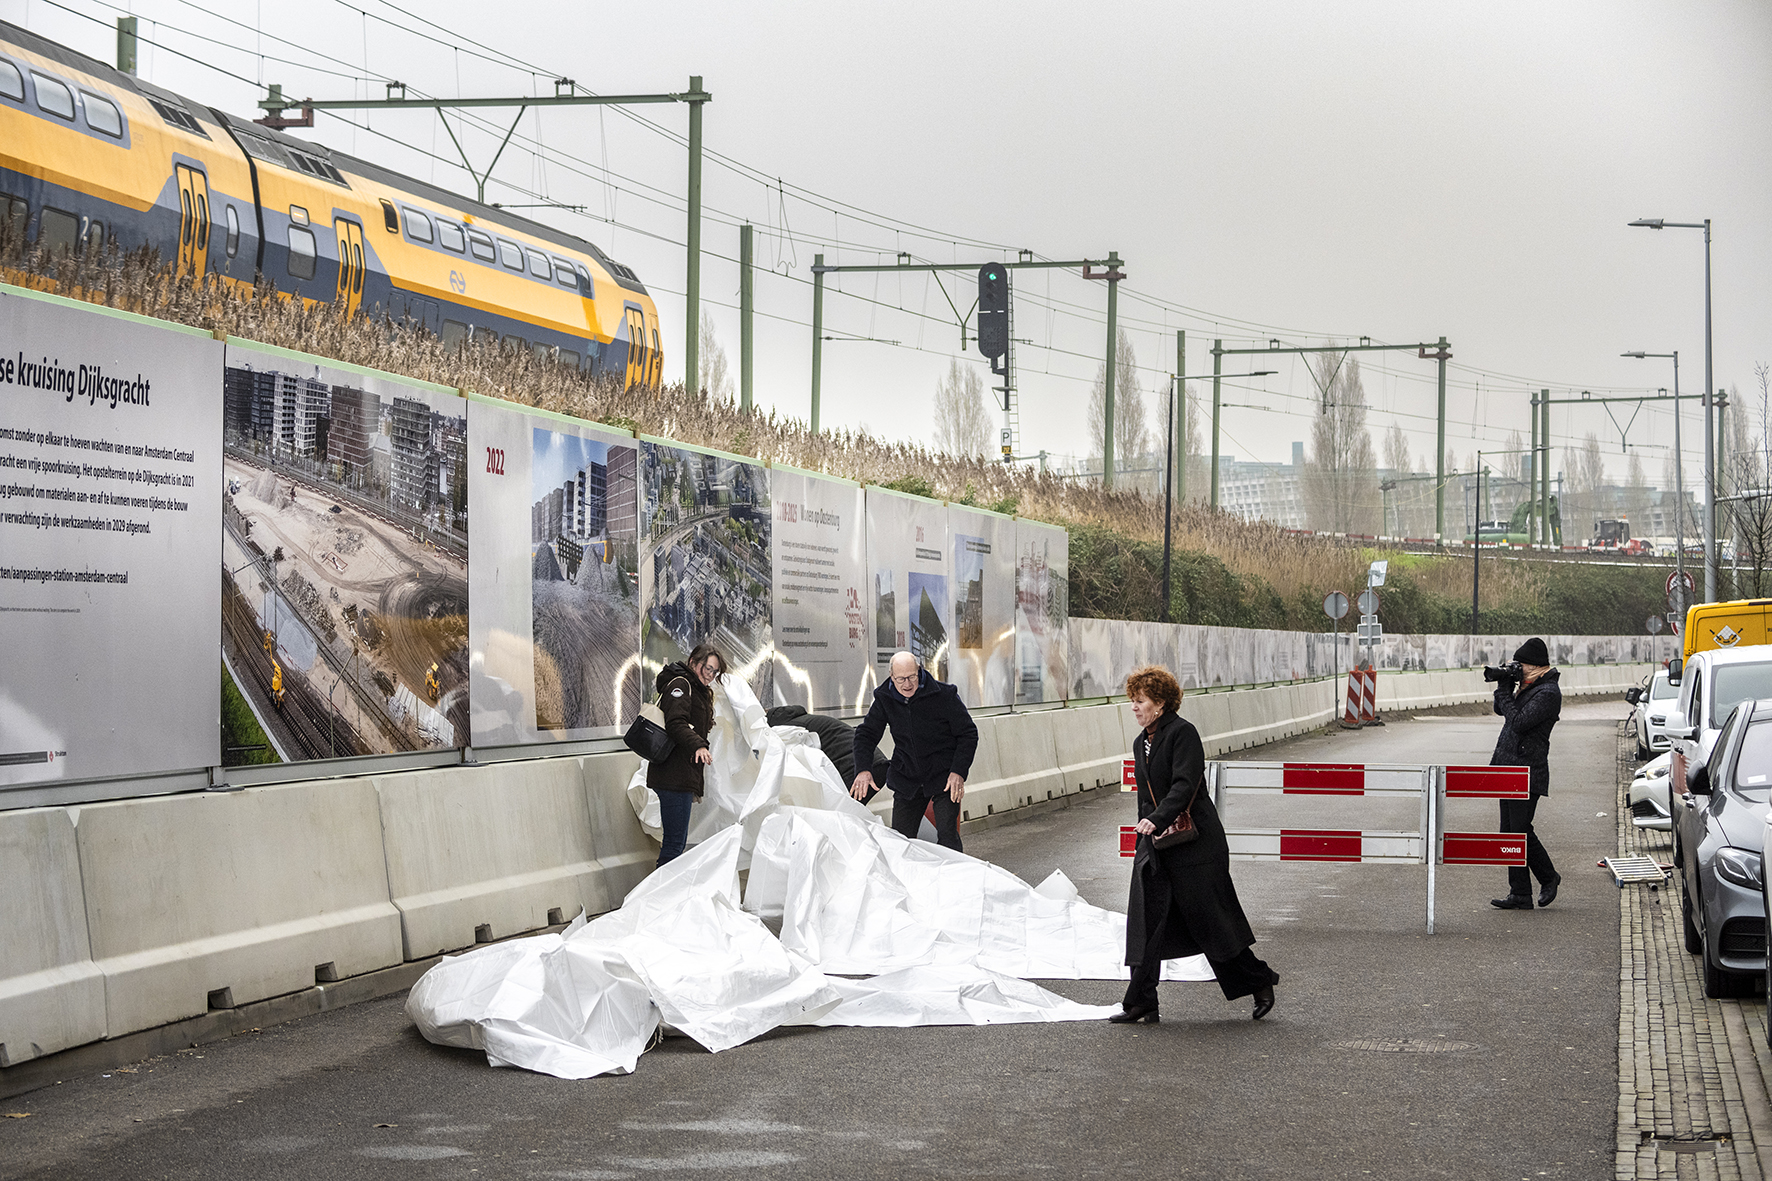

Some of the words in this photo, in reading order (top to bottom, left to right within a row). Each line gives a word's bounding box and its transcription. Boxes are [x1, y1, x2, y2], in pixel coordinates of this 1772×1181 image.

[18, 351, 75, 402] kruising
[78, 364, 150, 409] Dijksgracht
[15, 428, 36, 443] zonder
[36, 433, 44, 447] op
[45, 431, 63, 446] elkaar
[63, 435, 69, 447] te
[70, 434, 91, 450] hoeven
[91, 438, 113, 453] wachten
[114, 443, 124, 454] van
[125, 445, 131, 455] en
[132, 446, 144, 456] naar
[144, 445, 173, 460] Amsterdam
[173, 448, 194, 462] Centraal
[1002, 432, 1010, 443] P
[16, 458, 27, 469] een
[28, 456, 41, 474] vrije
[42, 459, 82, 479] spoorkruising.
[82, 463, 92, 476] Het
[93, 465, 127, 480] opstelterrein
[128, 470, 134, 484] op
[135, 469, 142, 482] de
[143, 469, 171, 487] Dijksgracht
[171, 473, 176, 486] is
[176, 473, 181, 486] in
[182, 474, 194, 487] 2021
[486, 446, 505, 476] 2022
[7, 482, 35, 499] gebouwd
[35, 488, 45, 499] om
[46, 487, 76, 501] materialen
[77, 491, 89, 503] aan-
[90, 493, 97, 503] en
[97, 491, 104, 504] af
[104, 493, 109, 505] te
[110, 492, 130, 506] kunnen
[131, 497, 148, 508] voeren
[149, 496, 167, 512] tijdens
[167, 497, 173, 510] de
[174, 498, 188, 511] bouw
[4, 510, 41, 529] verwachting
[41, 513, 52, 530] zijn
[52, 513, 60, 527] de
[60, 514, 105, 531] werkzaamheden
[106, 518, 111, 531] in
[112, 519, 126, 532] 2029
[126, 519, 151, 536] afgerond.
